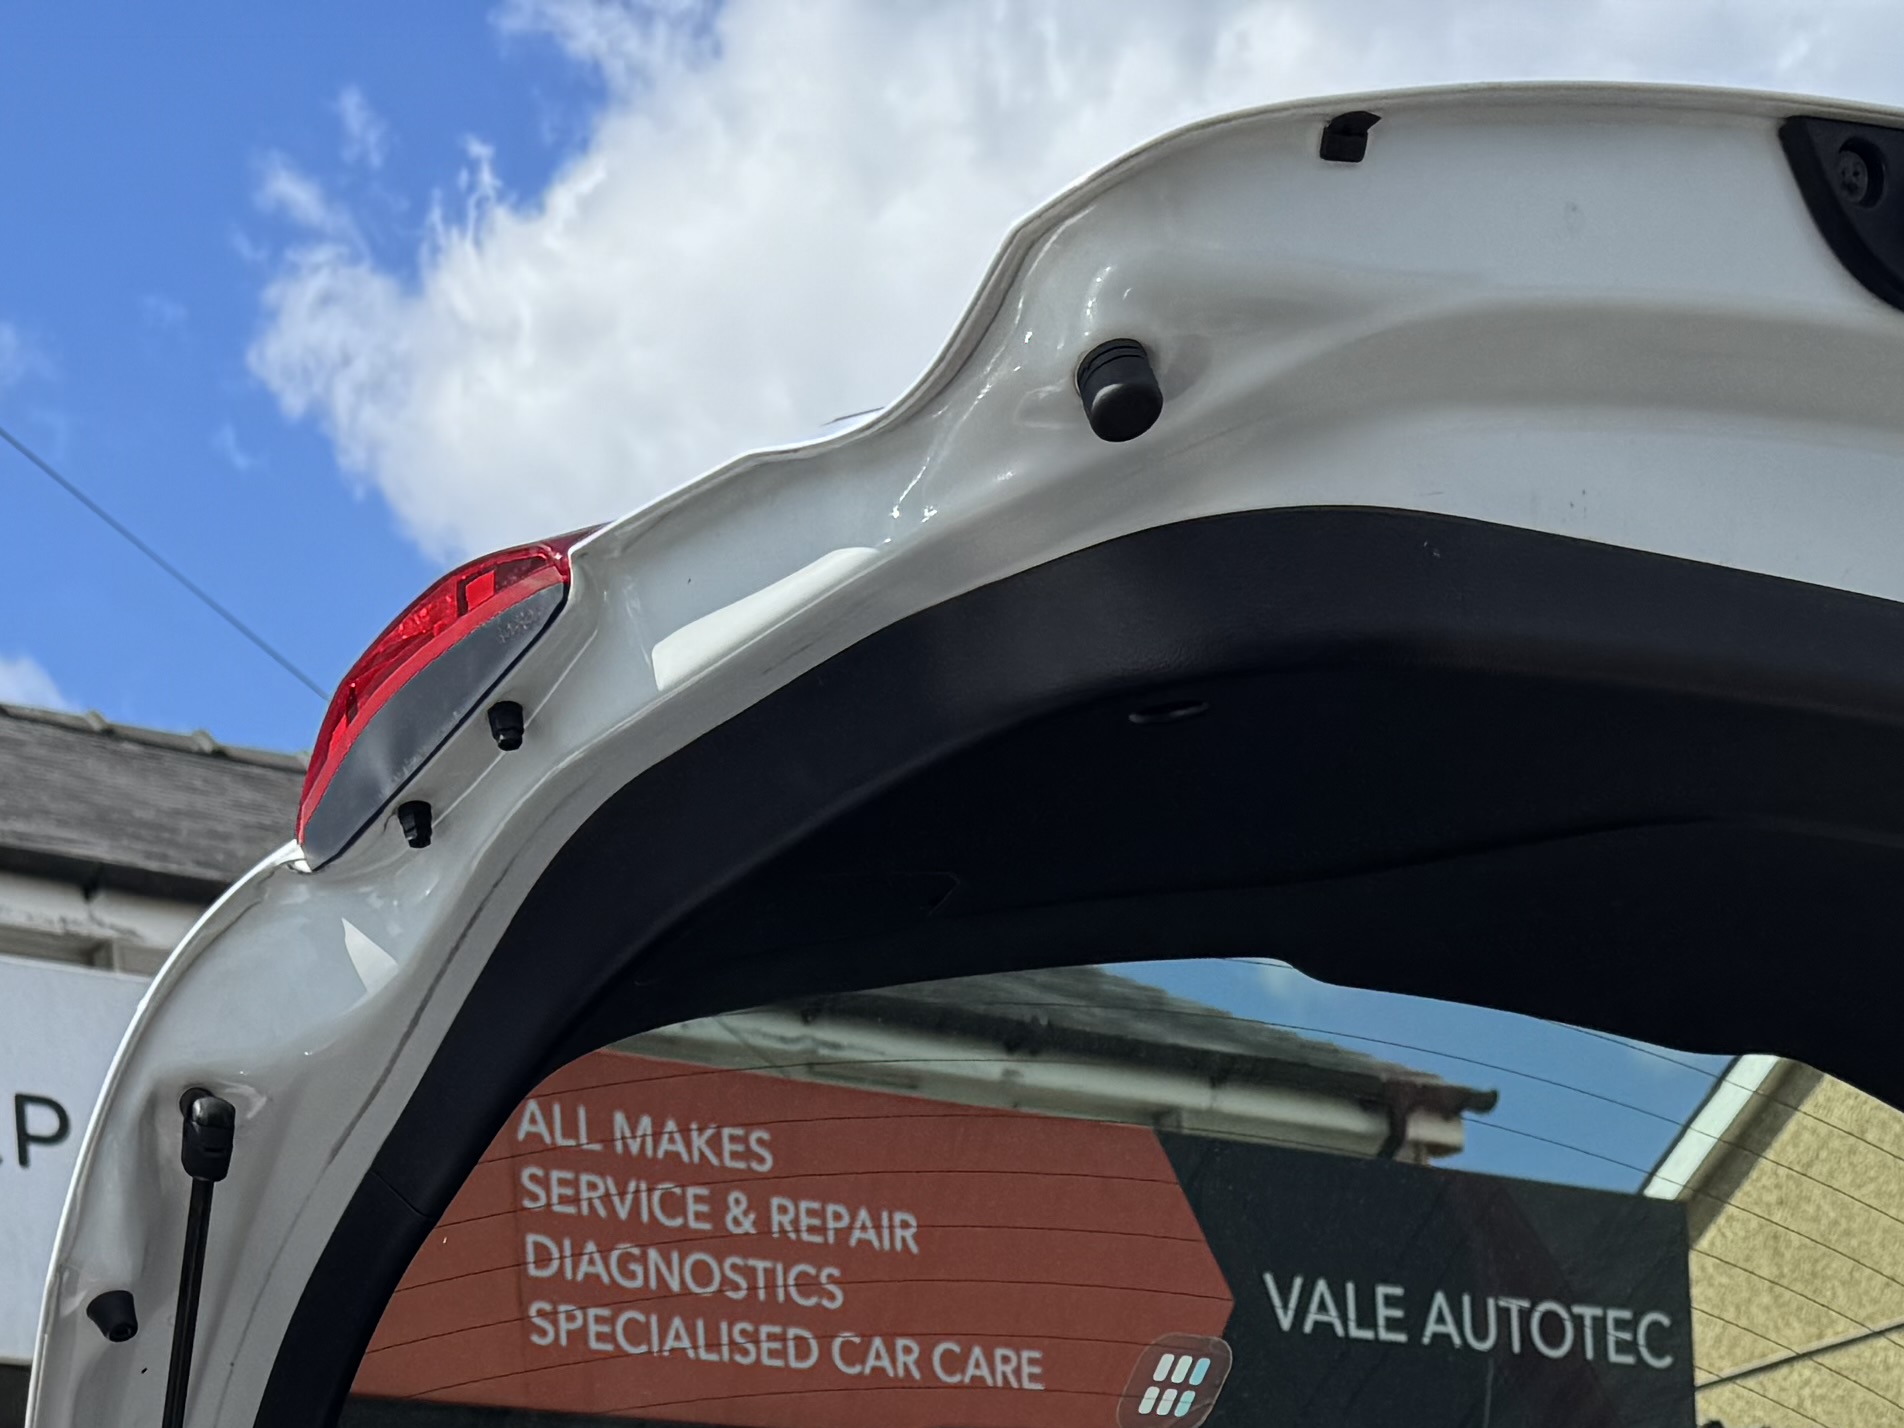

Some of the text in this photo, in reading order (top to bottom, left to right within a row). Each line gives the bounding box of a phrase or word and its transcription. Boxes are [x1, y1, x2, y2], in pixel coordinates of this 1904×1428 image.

[517, 1099, 774, 1173] ALL MAKES
[519, 1167, 919, 1254] SERVICE & REPAIR
[524, 1233, 845, 1310] DIAGNOSTICS
[528, 1301, 1045, 1391] SPECIALISED CAR CARE
[1263, 1271, 1674, 1370] VALE AUTOTEC
